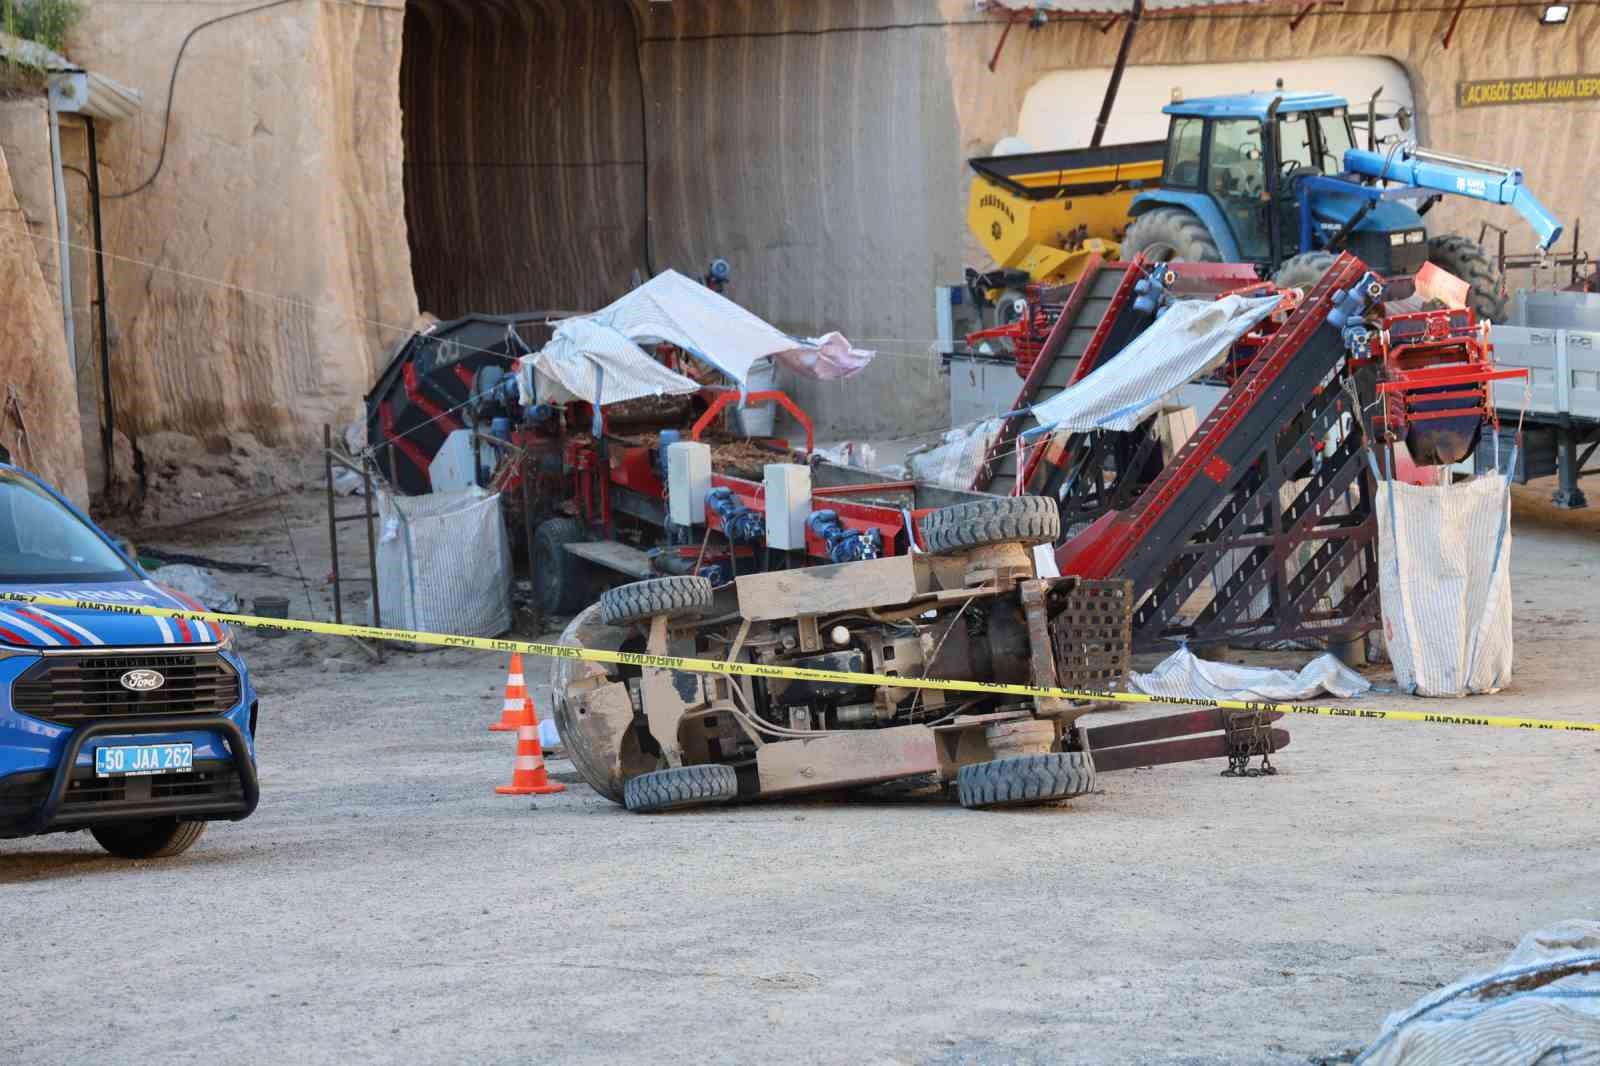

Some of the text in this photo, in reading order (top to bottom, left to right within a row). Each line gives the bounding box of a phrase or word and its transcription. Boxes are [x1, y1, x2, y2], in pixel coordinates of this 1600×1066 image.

[1548, 79, 1575, 98] HAVA
[128, 671, 157, 688] Ford
[105, 747, 190, 769] 50 JAA 262
